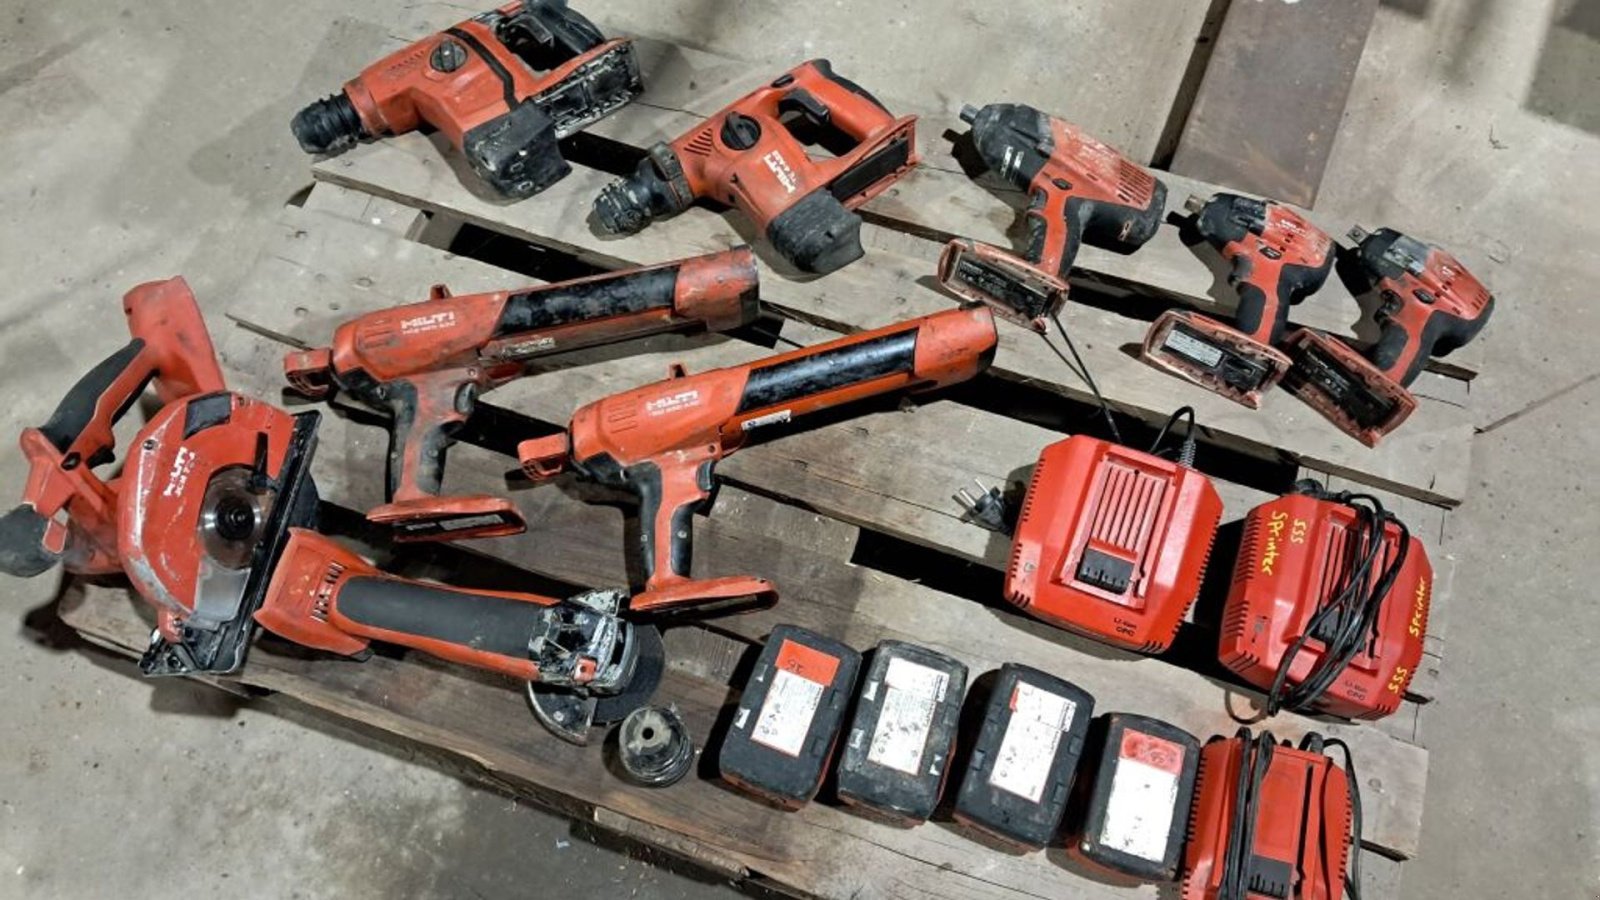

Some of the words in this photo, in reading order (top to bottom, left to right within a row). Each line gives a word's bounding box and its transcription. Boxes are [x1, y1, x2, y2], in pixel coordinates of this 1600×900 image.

[763, 152, 796, 193] HILTI
[401, 312, 455, 330] HILTI
[645, 390, 699, 411] HILTI
[163, 446, 188, 496] HILTI
[1290, 518, 1307, 545] SSS
[1388, 666, 1408, 694] SSS
